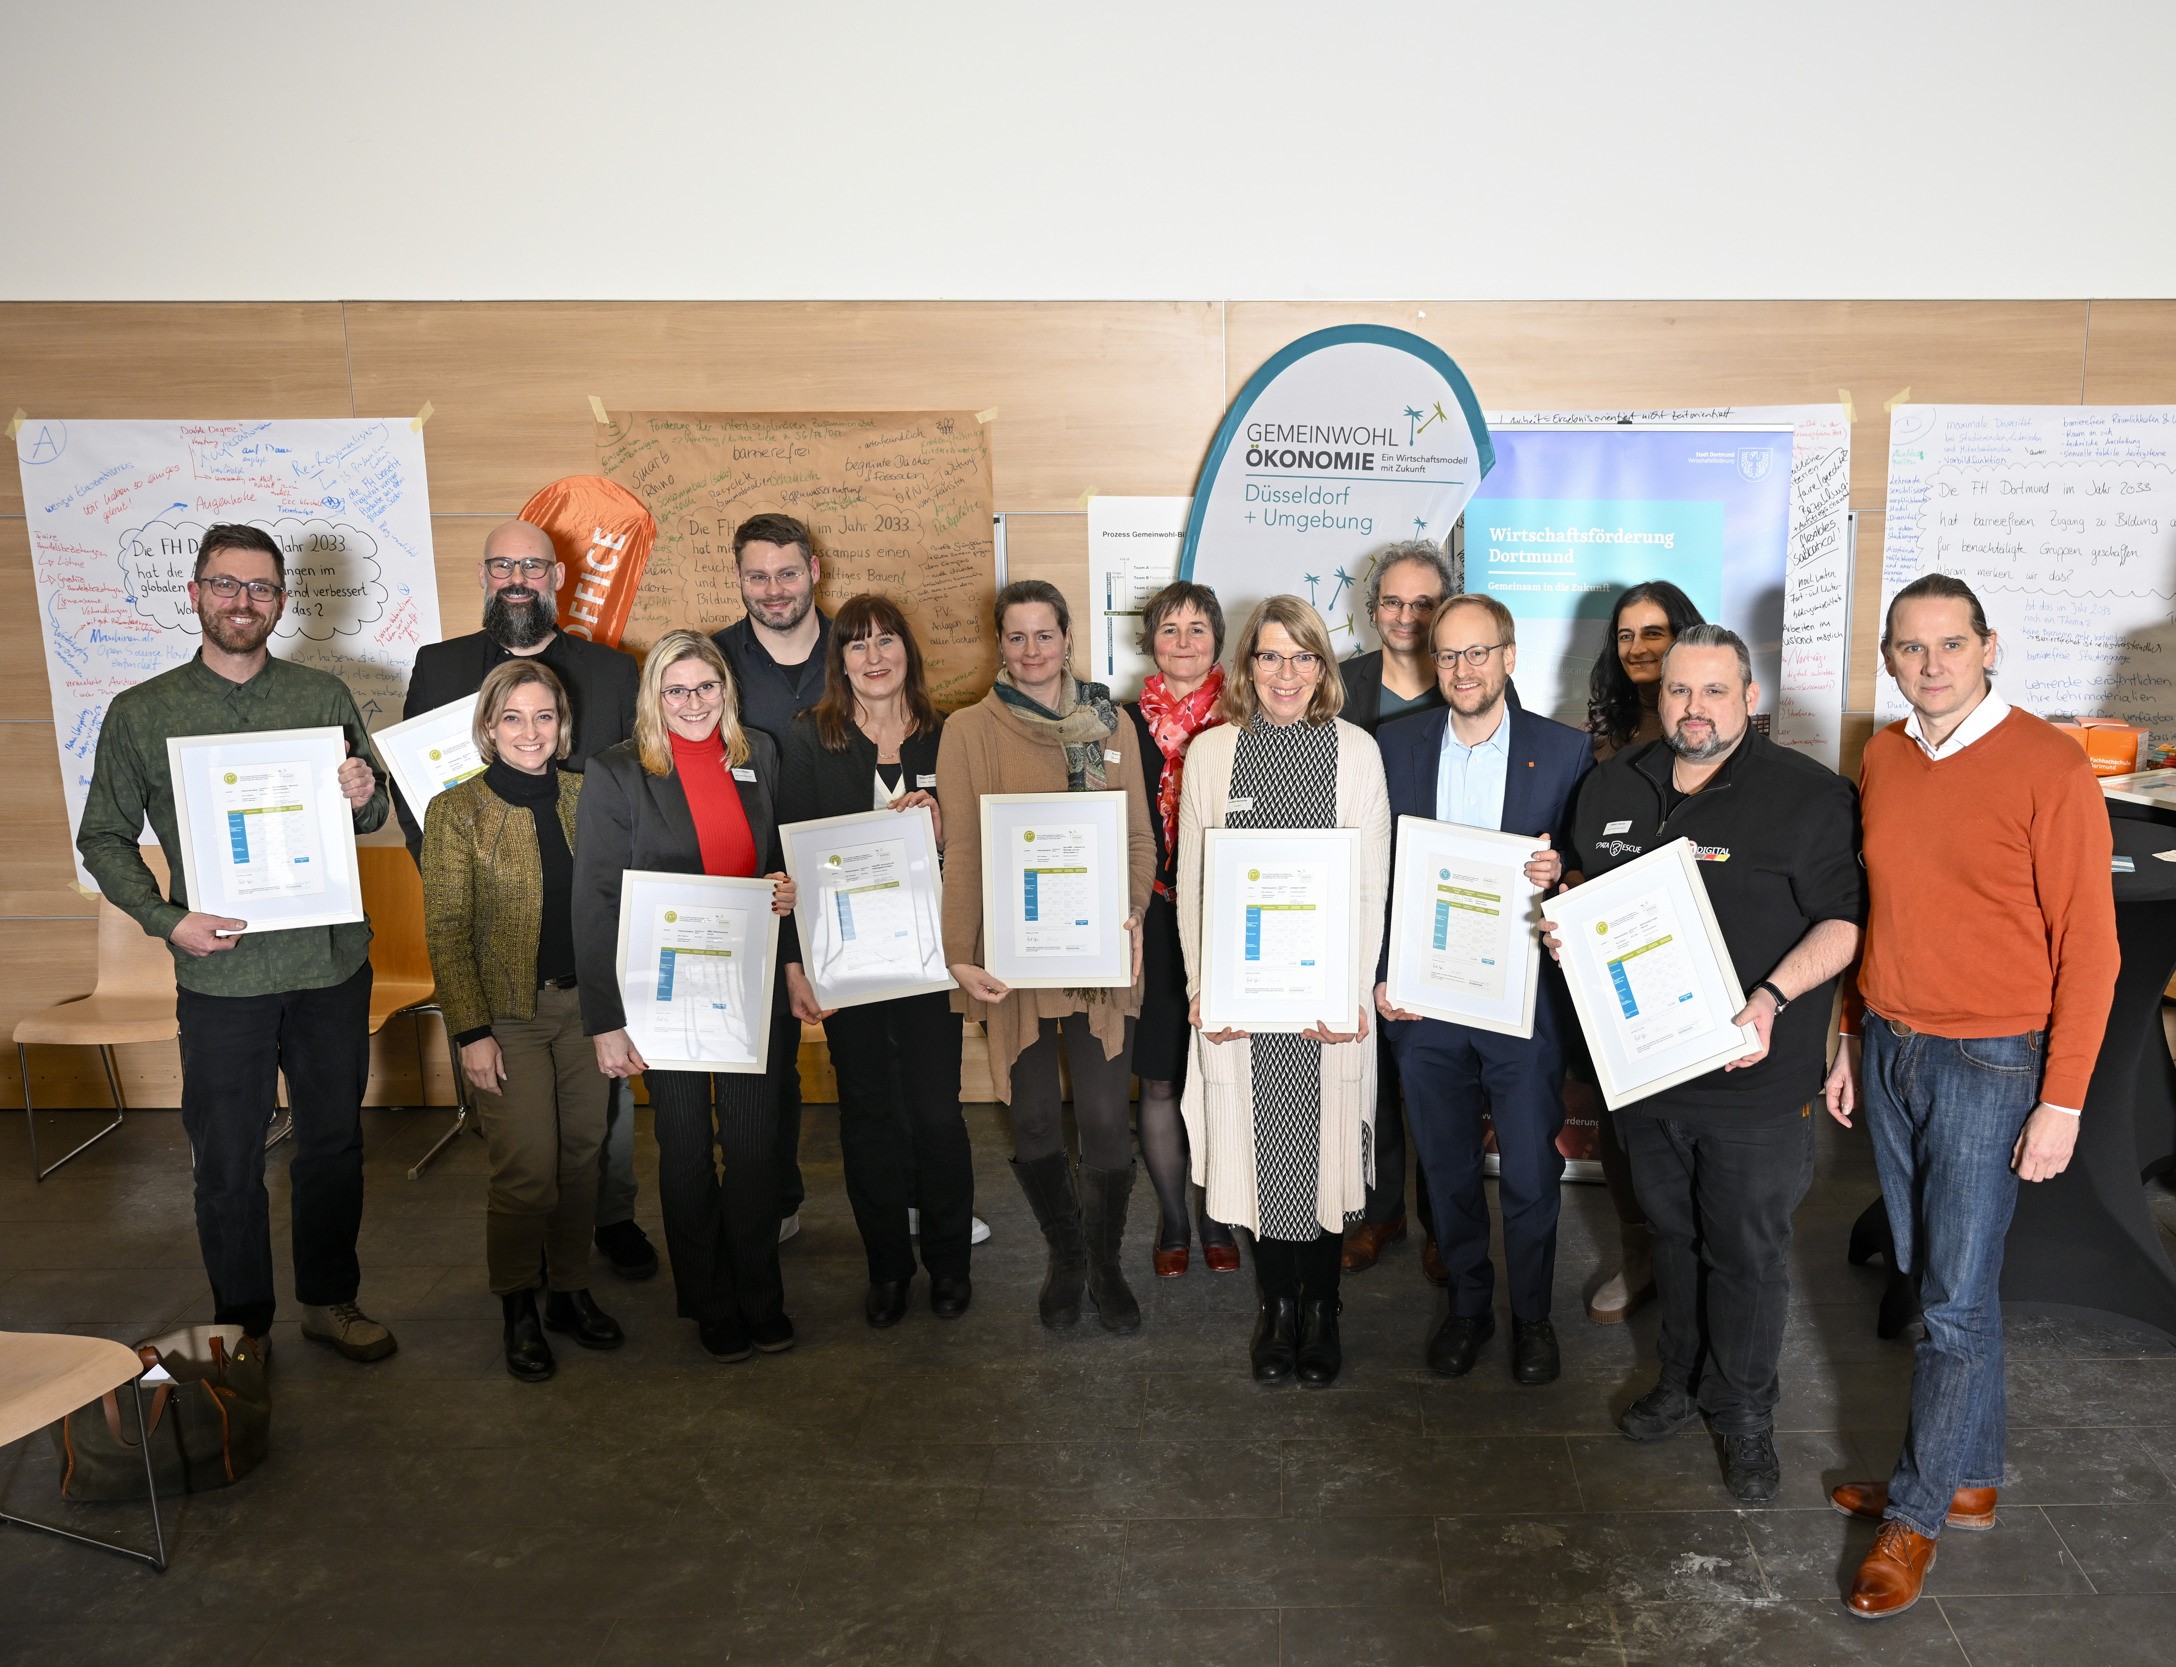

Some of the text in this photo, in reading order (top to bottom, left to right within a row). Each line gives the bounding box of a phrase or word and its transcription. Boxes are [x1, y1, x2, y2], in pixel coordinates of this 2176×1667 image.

[1946, 416, 1988, 429] maximale
[1246, 423, 1399, 446] GEMEINWOHL
[2066, 429, 2085, 438] Raum
[33, 426, 57, 459] A
[1245, 444, 1375, 471] ÖKONOMIE
[1381, 454, 1468, 465] Ein Wirtschaftsmodell
[1395, 465, 1426, 473] Zukunft
[641, 475, 675, 498] Rhino
[1245, 484, 1350, 505] Düsseldorf
[1971, 481, 1989, 496] FH
[2000, 480, 2050, 496] Dortmund
[2063, 483, 2075, 495] im
[2085, 479, 2111, 496] Jahr
[197, 493, 257, 515] Augenhöhe
[689, 519, 710, 536] Die
[717, 518, 736, 536] FH
[818, 521, 831, 533] im
[838, 515, 868, 534] Jahr
[1245, 508, 1373, 535] + Umgebung
[1939, 511, 1959, 527] hat
[2050, 509, 2085, 534] Zugang
[2096, 518, 2107, 527] zu
[2115, 512, 2158, 535] Bildung
[133, 540, 154, 557] Die
[161, 538, 182, 555] FH
[274, 535, 303, 554] Jahr
[1489, 527, 1675, 549] Wirtschaftsförderung
[691, 540, 711, 554] hat
[876, 548, 910, 558] einen
[1488, 548, 1575, 564] Dortmund
[1937, 536, 1951, 560] für
[2040, 542, 2083, 562] Gruppen
[136, 562, 335, 579] hat die im
[1977, 568, 2014, 580] merken
[2026, 572, 2039, 580] wir
[2048, 569, 2075, 582] das?
[140, 582, 186, 599] globalen
[696, 577, 717, 589] und
[1488, 582, 1611, 592] Gemeinsam in die Zukunft
[292, 602, 312, 616] das
[697, 593, 741, 609] Bildung
[2040, 600, 2053, 611] das
[699, 609, 732, 623] Woran
[2025, 672, 2172, 690] Lehrende veröffentlichen
[2027, 690, 2157, 704] ihre Lehrmaterialien
[2090, 757, 2132, 766] Fachhochschule
[1696, 847, 1730, 855] DIGITAL
